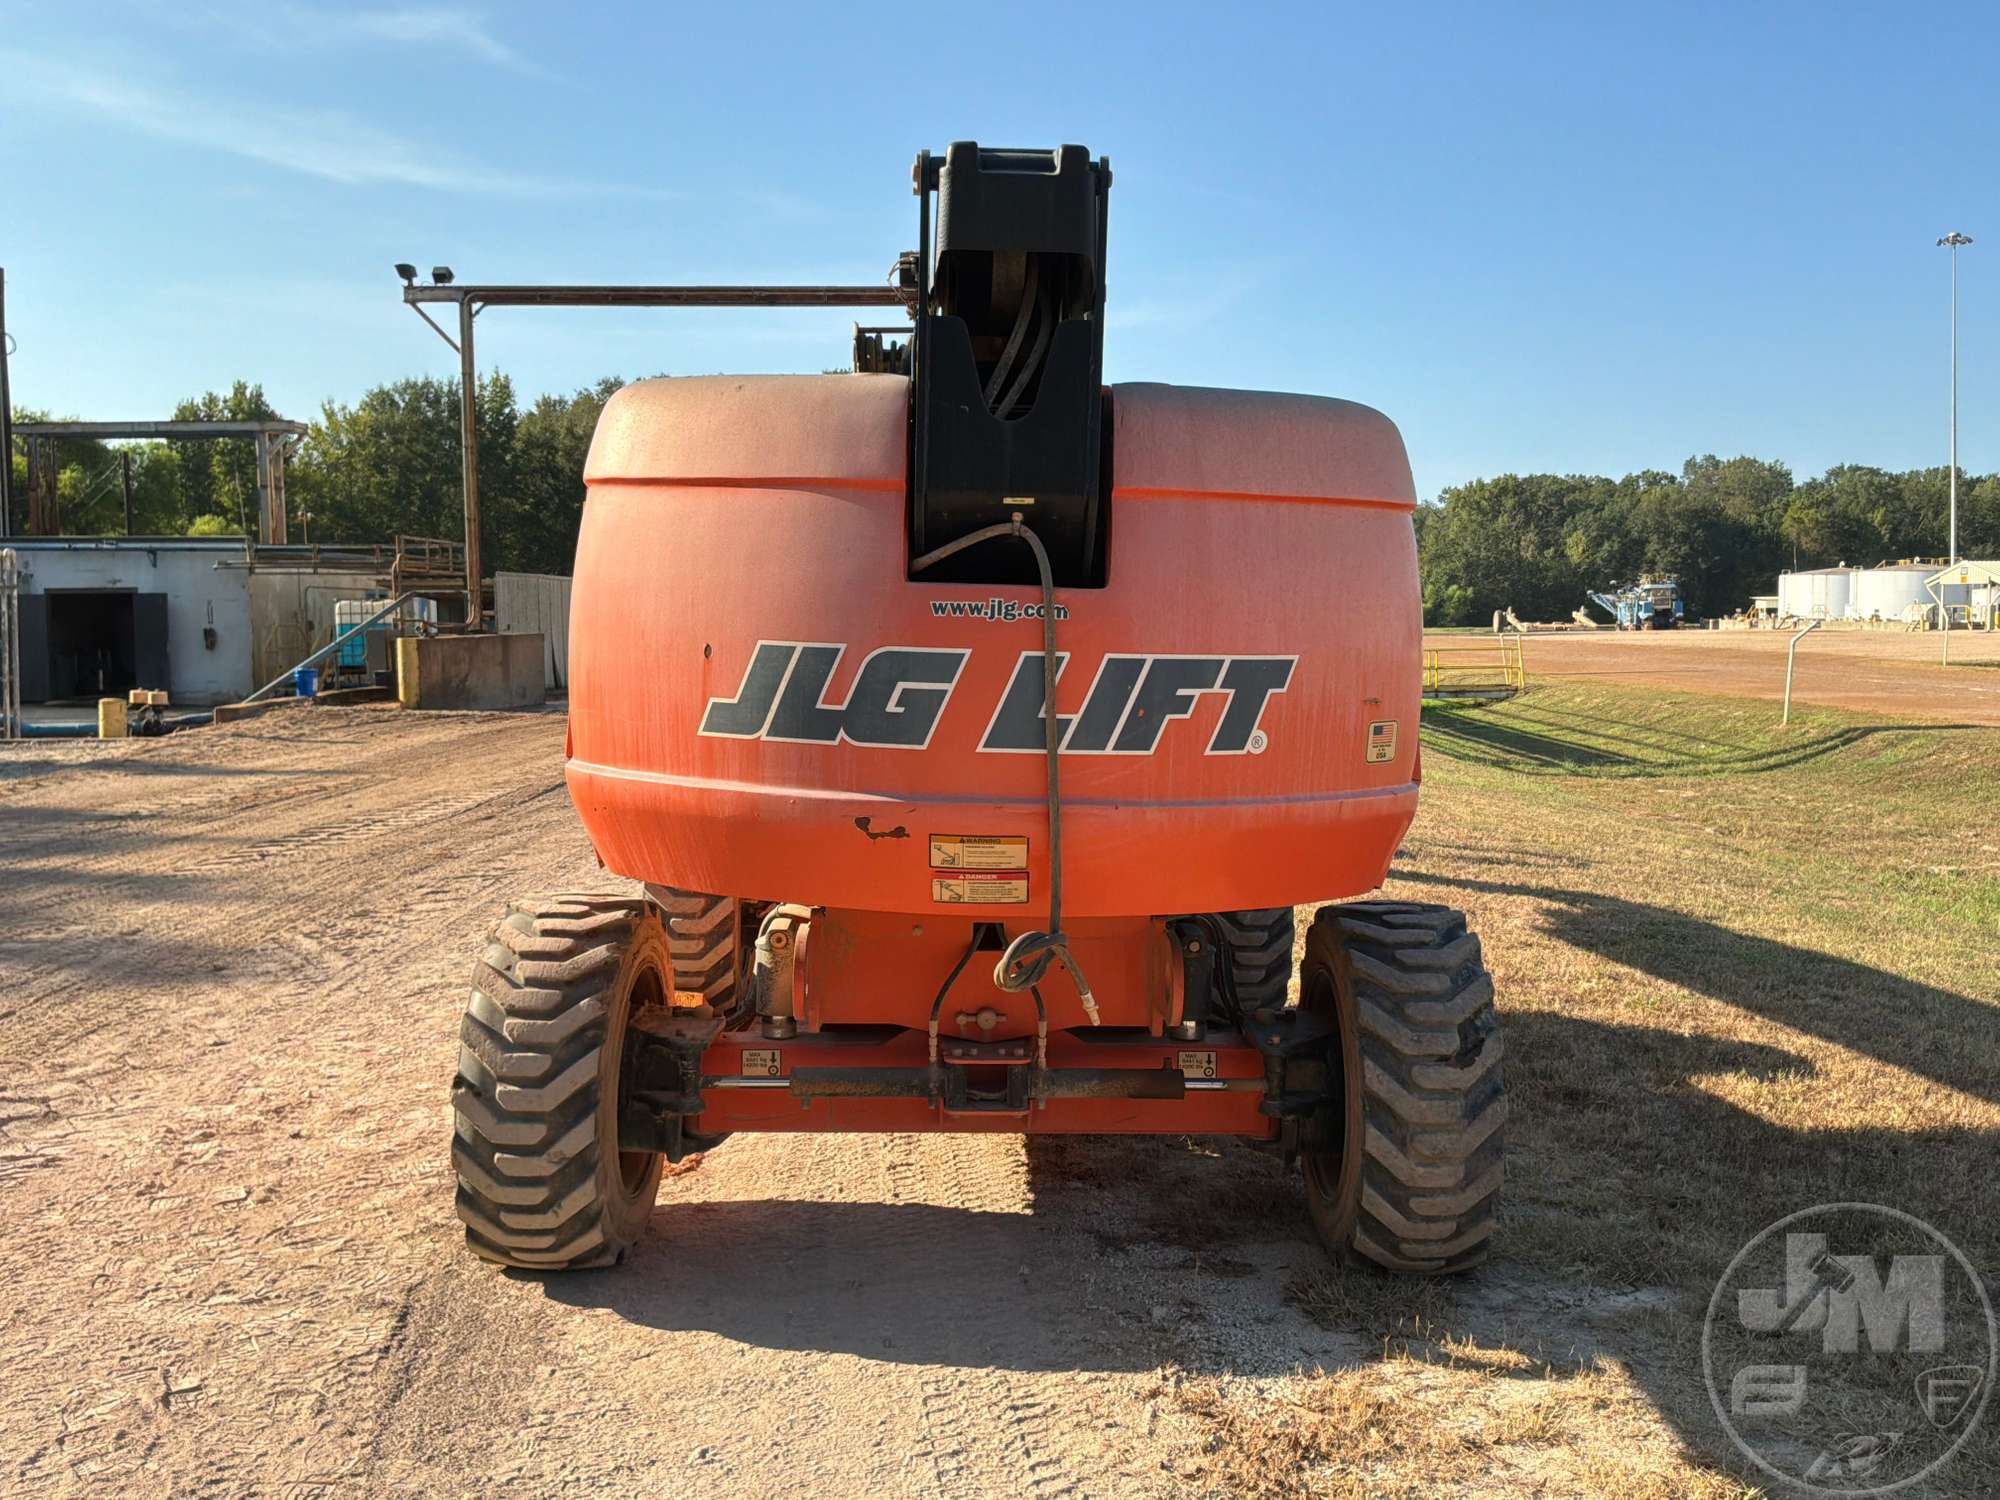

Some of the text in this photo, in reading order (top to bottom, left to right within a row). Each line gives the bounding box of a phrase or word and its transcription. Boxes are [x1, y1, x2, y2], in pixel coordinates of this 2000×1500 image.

[930, 597, 1069, 621] www.jlg.com
[697, 640, 1299, 755] JLG LIFT
